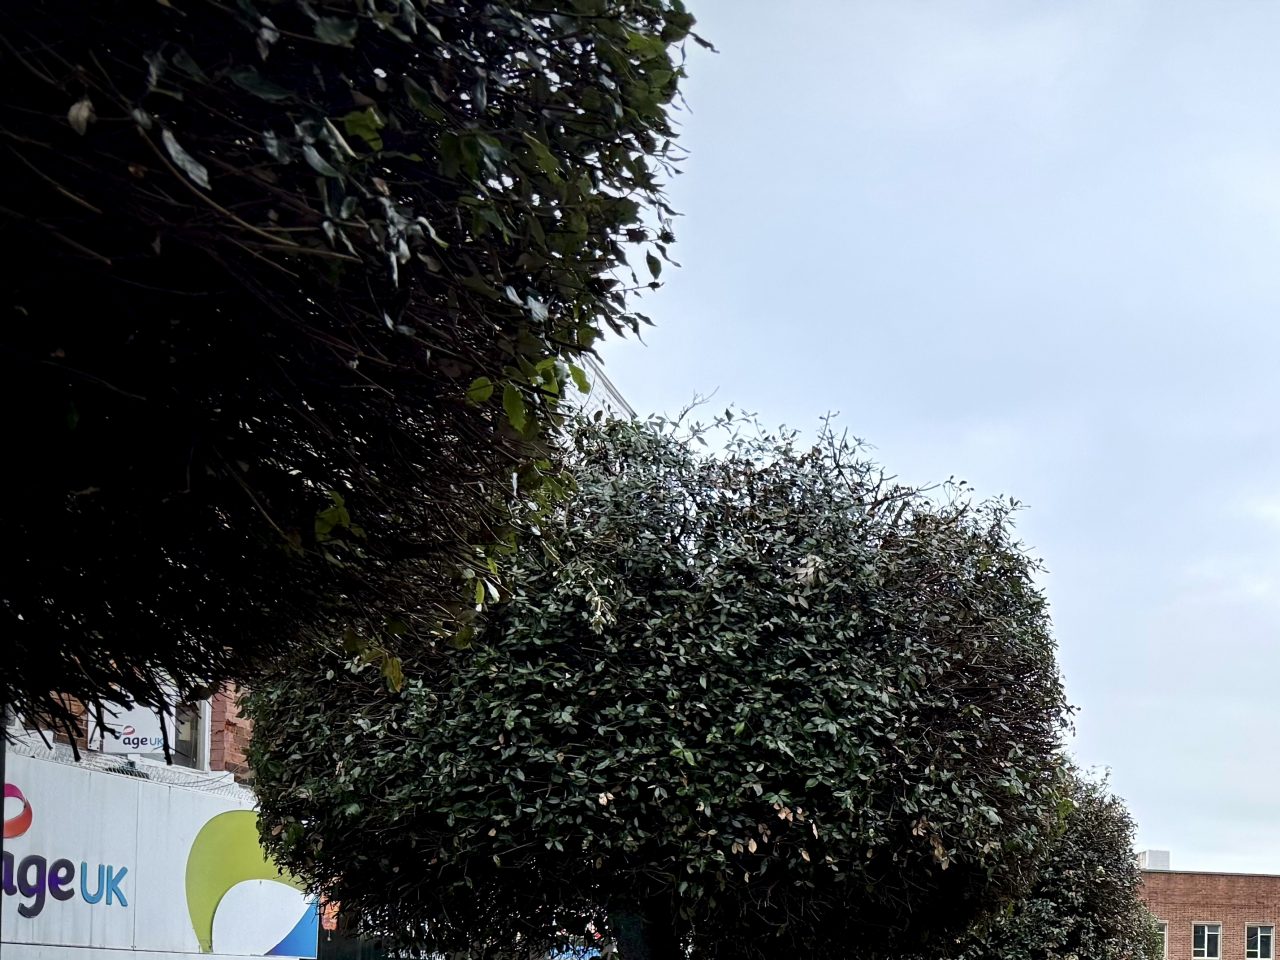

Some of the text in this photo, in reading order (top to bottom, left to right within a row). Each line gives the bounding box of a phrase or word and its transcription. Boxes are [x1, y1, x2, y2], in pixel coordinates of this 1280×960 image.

[122, 736, 164, 749] age UK
[80, 861, 128, 907] UK
